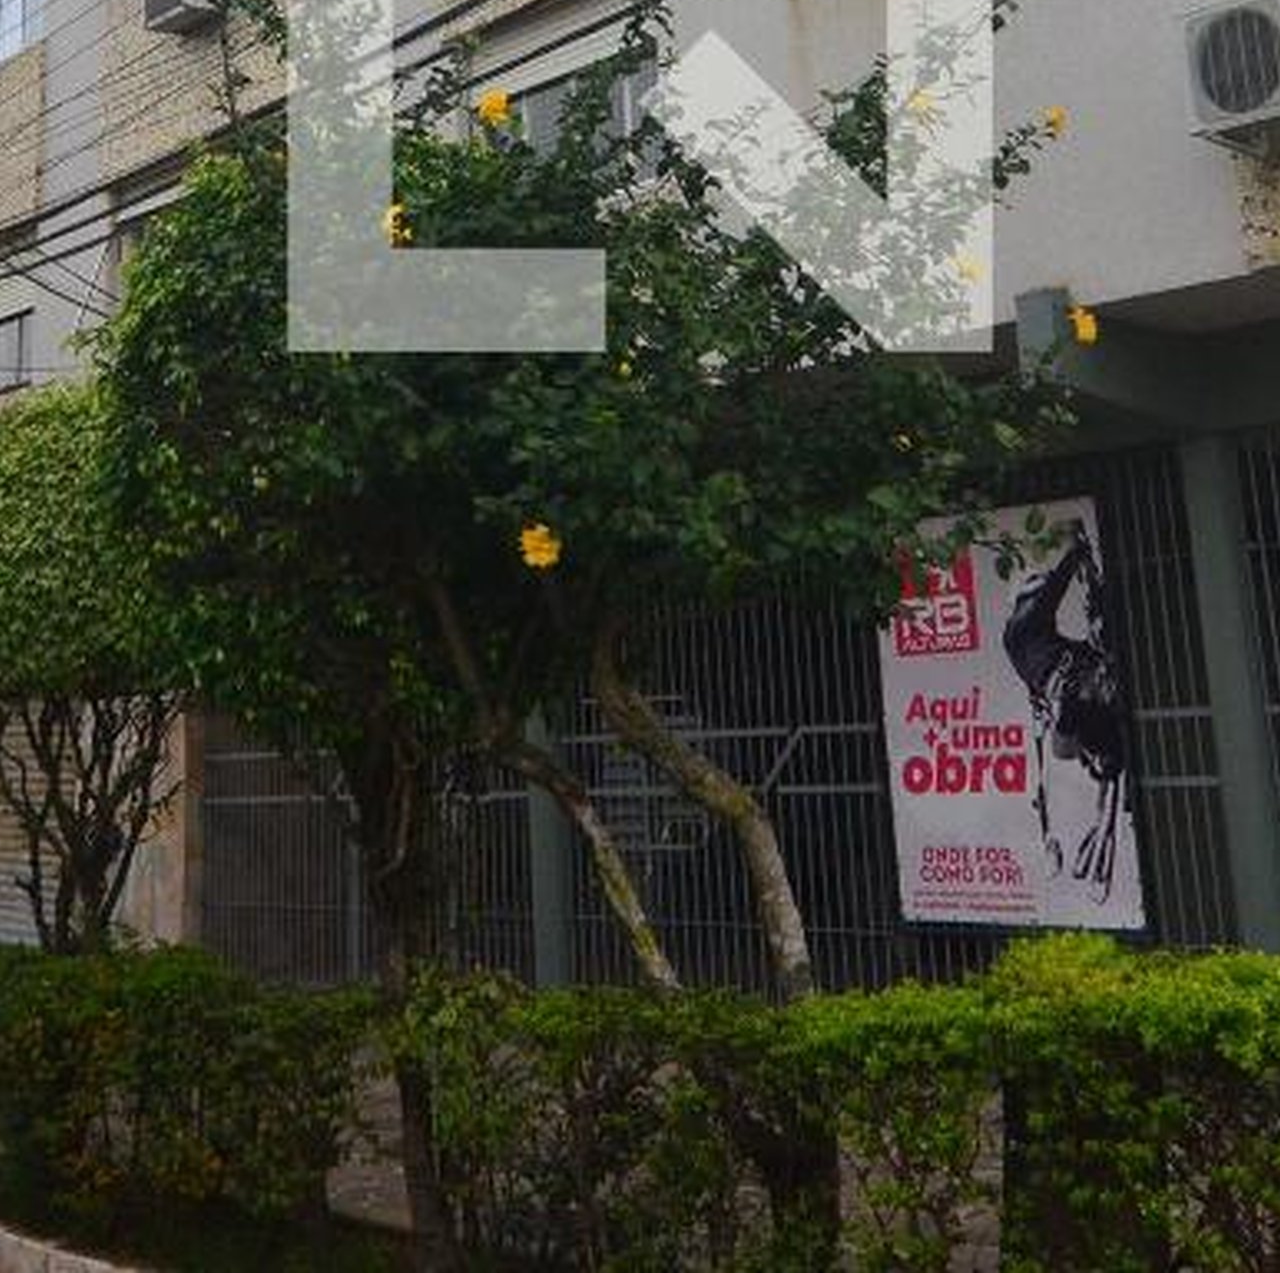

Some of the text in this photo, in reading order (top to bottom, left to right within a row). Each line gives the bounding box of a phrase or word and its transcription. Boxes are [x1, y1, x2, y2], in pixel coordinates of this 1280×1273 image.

[905, 686, 981, 729] Aqui
[951, 724, 1024, 748] uma
[903, 742, 1027, 794] obra
